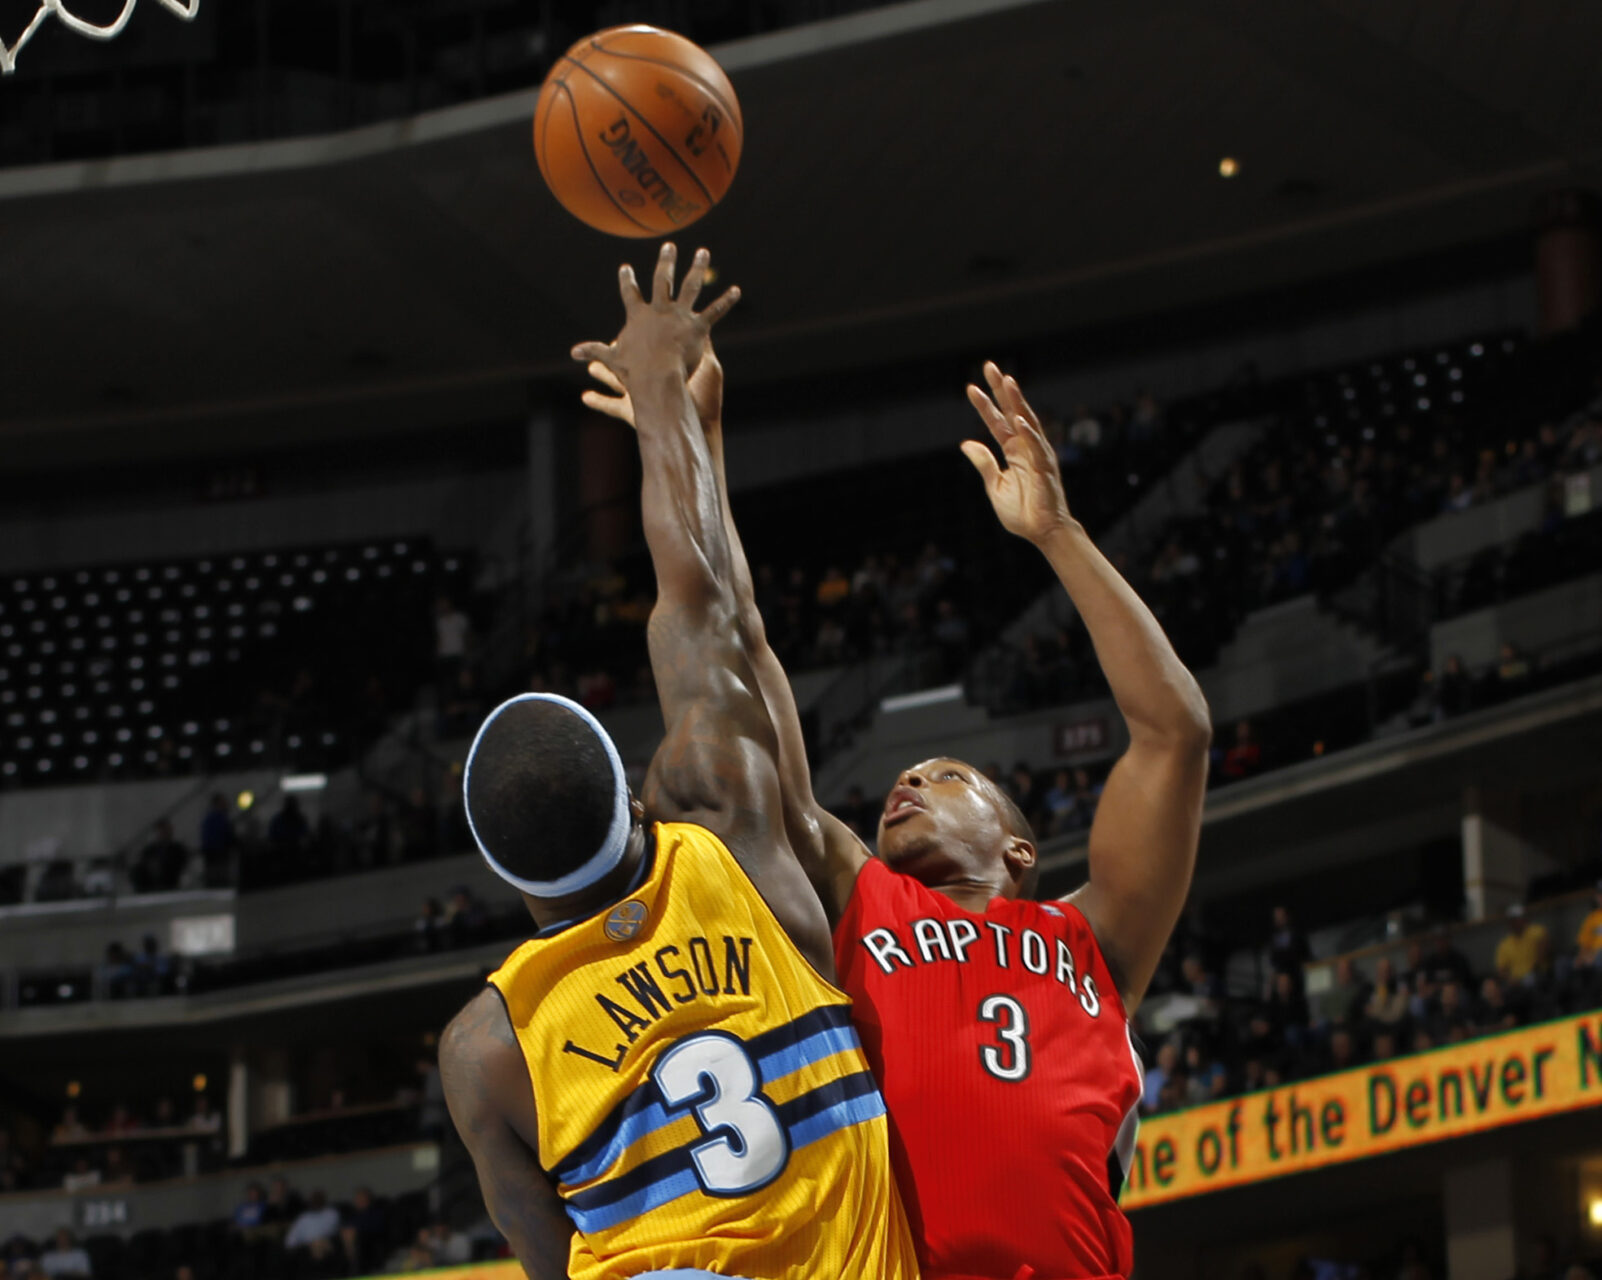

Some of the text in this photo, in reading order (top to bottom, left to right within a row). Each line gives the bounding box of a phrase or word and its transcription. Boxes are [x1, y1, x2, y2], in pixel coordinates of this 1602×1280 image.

[562, 935, 753, 1073] LAWSON
[861, 917, 1101, 1018] RAPTORS
[977, 993, 1031, 1083] 3
[647, 1028, 793, 1199] 3
[1196, 1101, 1243, 1178] of
[1263, 1093, 1345, 1161] the
[1368, 1049, 1556, 1137] Denver
